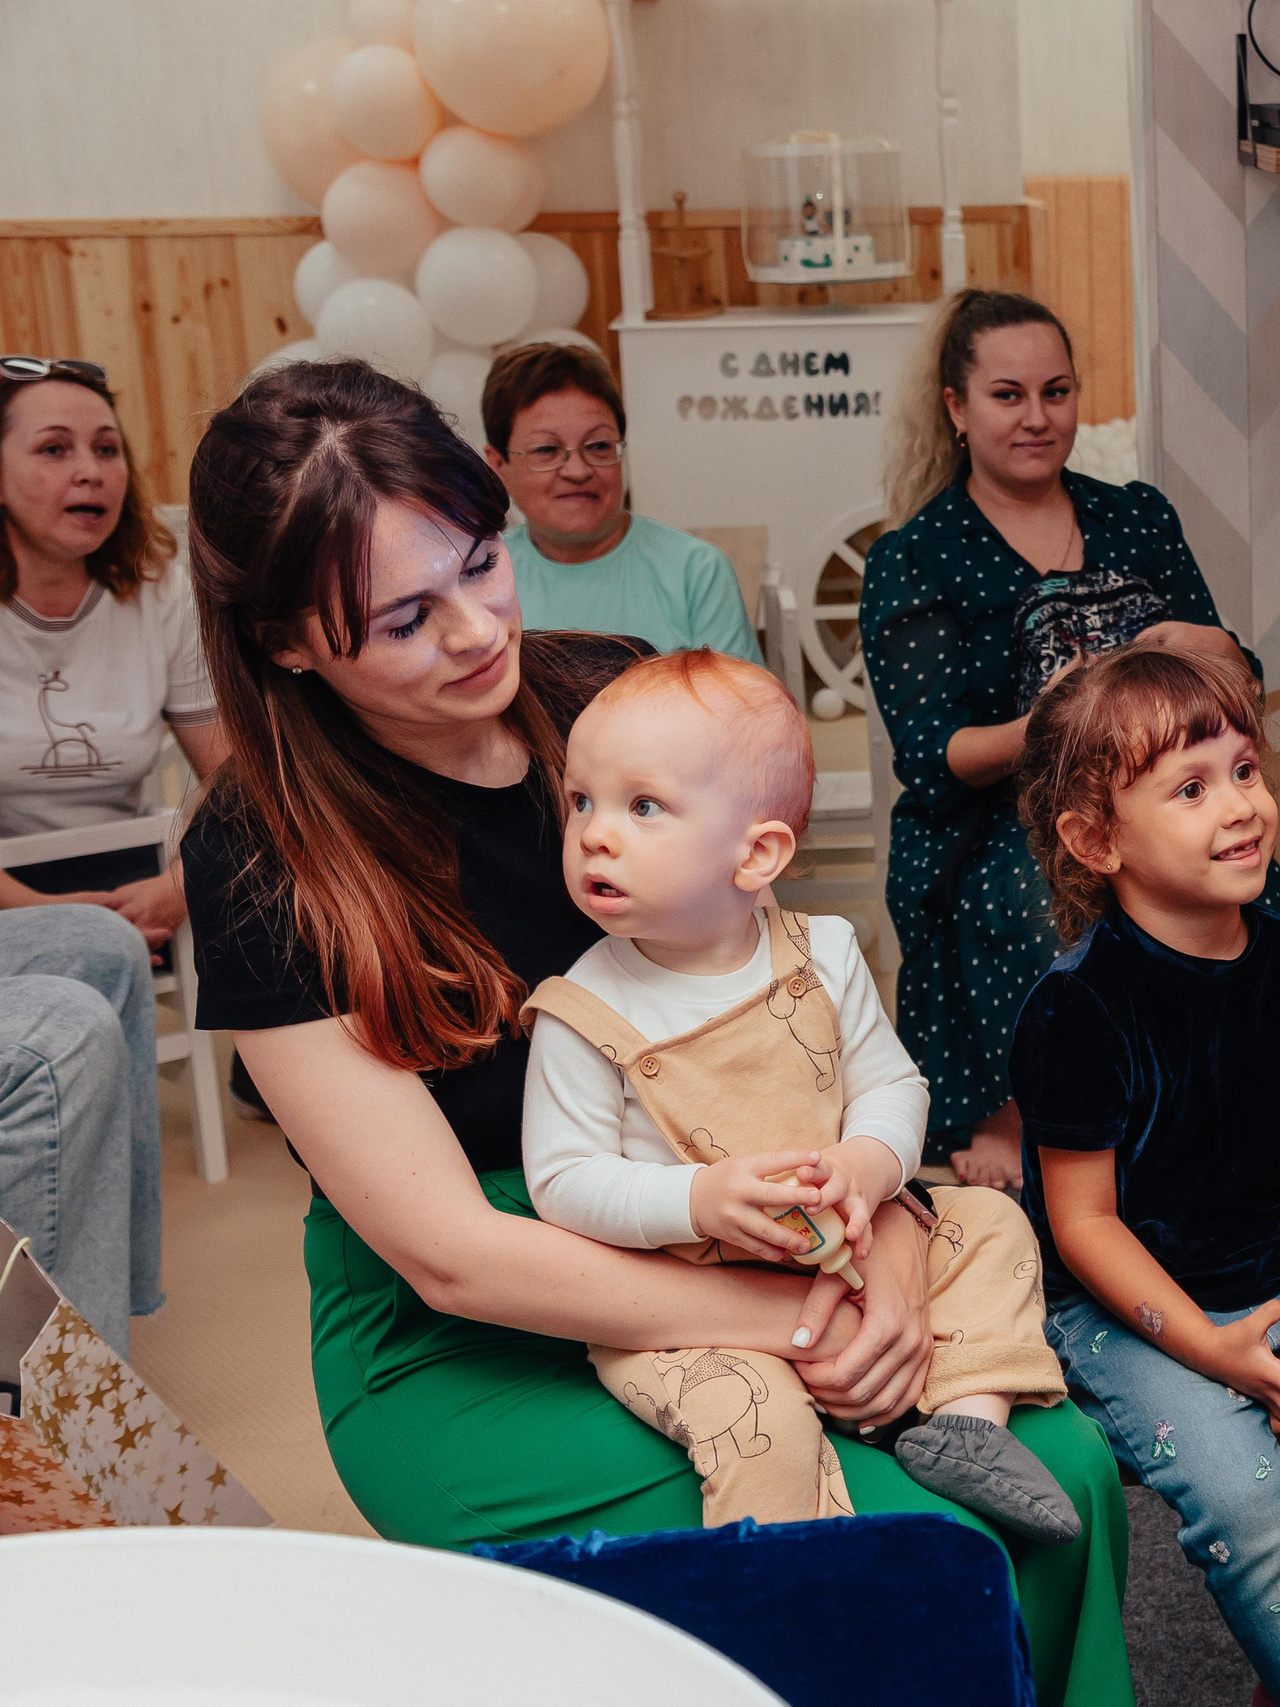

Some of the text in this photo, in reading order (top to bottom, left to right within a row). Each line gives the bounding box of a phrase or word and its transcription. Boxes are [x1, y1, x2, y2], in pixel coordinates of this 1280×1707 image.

[719, 351, 850, 378] С ДНЕМ
[677, 391, 881, 421] РОЖДЕНИЯ!
